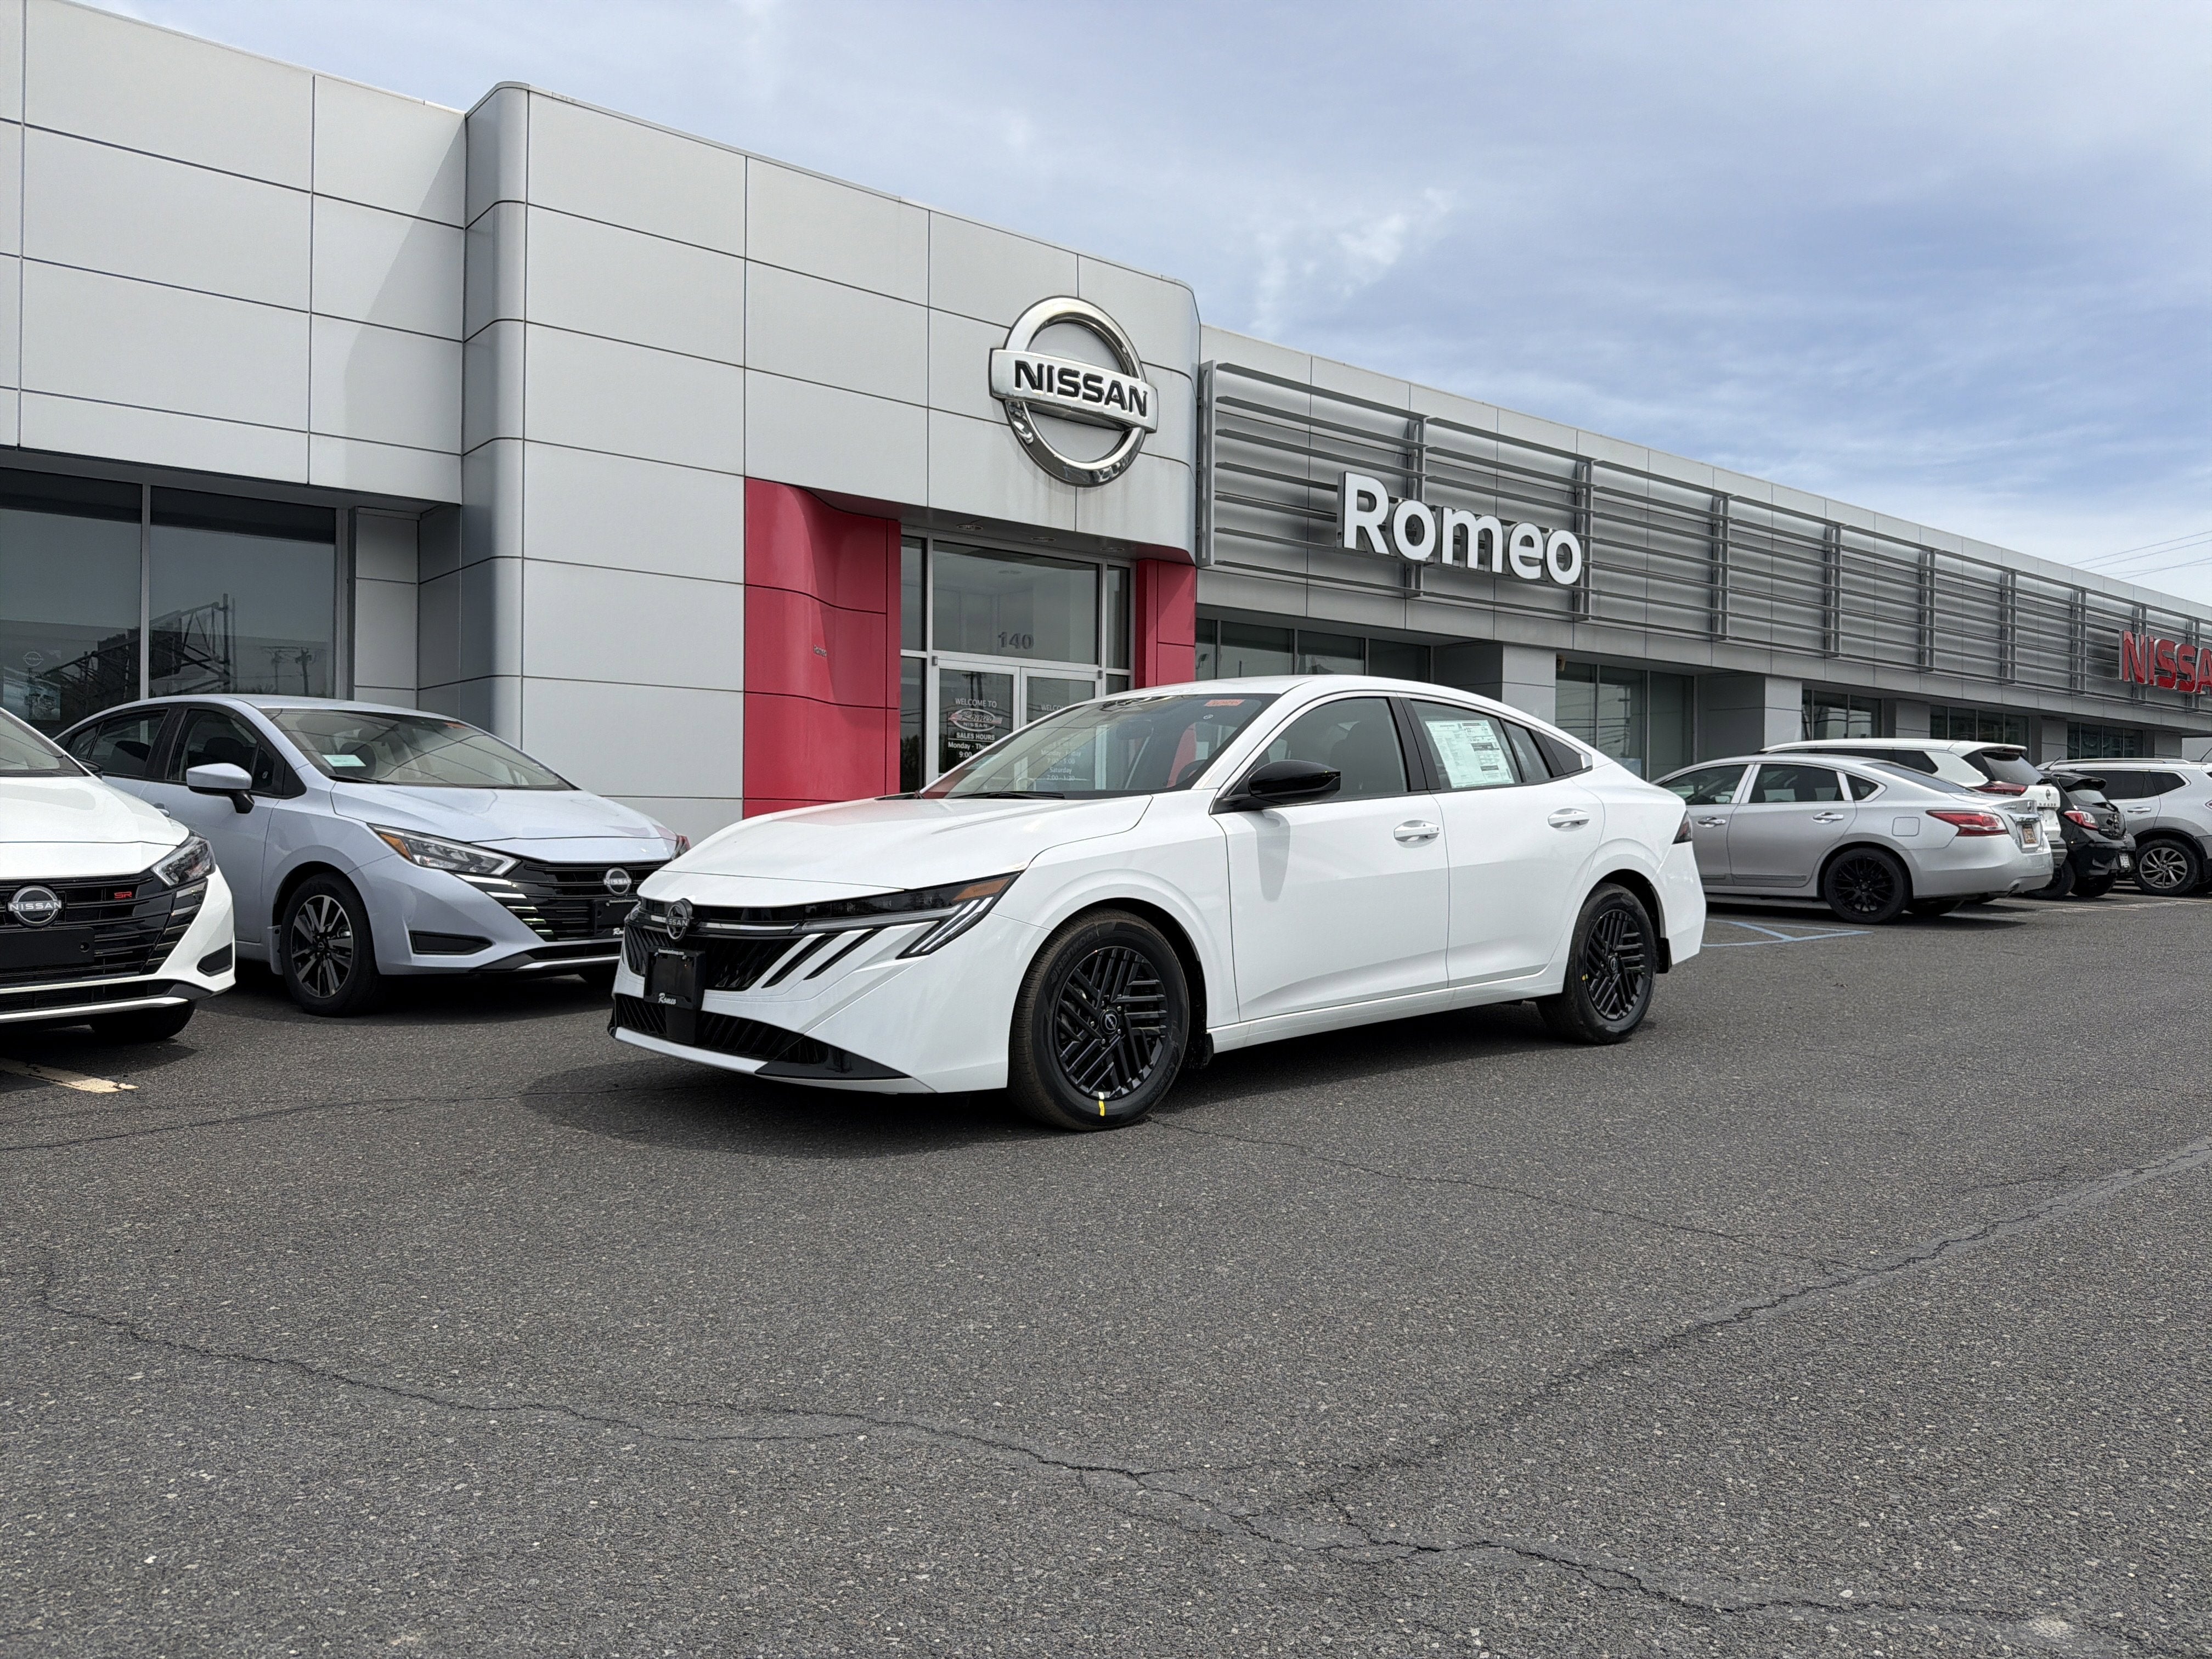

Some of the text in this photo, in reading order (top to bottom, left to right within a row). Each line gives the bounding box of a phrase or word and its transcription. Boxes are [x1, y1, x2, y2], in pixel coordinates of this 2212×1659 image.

[1014, 360, 1148, 419] NISSAN
[1341, 471, 1582, 585] Romeo
[998, 631, 1034, 649] 140
[2122, 630, 2212, 696] NISSA
[955, 698, 986, 707] WELCOME
[961, 710, 994, 723] Romeo
[948, 742, 970, 751] Monday
[114, 891, 132, 900] SR
[9, 901, 61, 911] NISSAN
